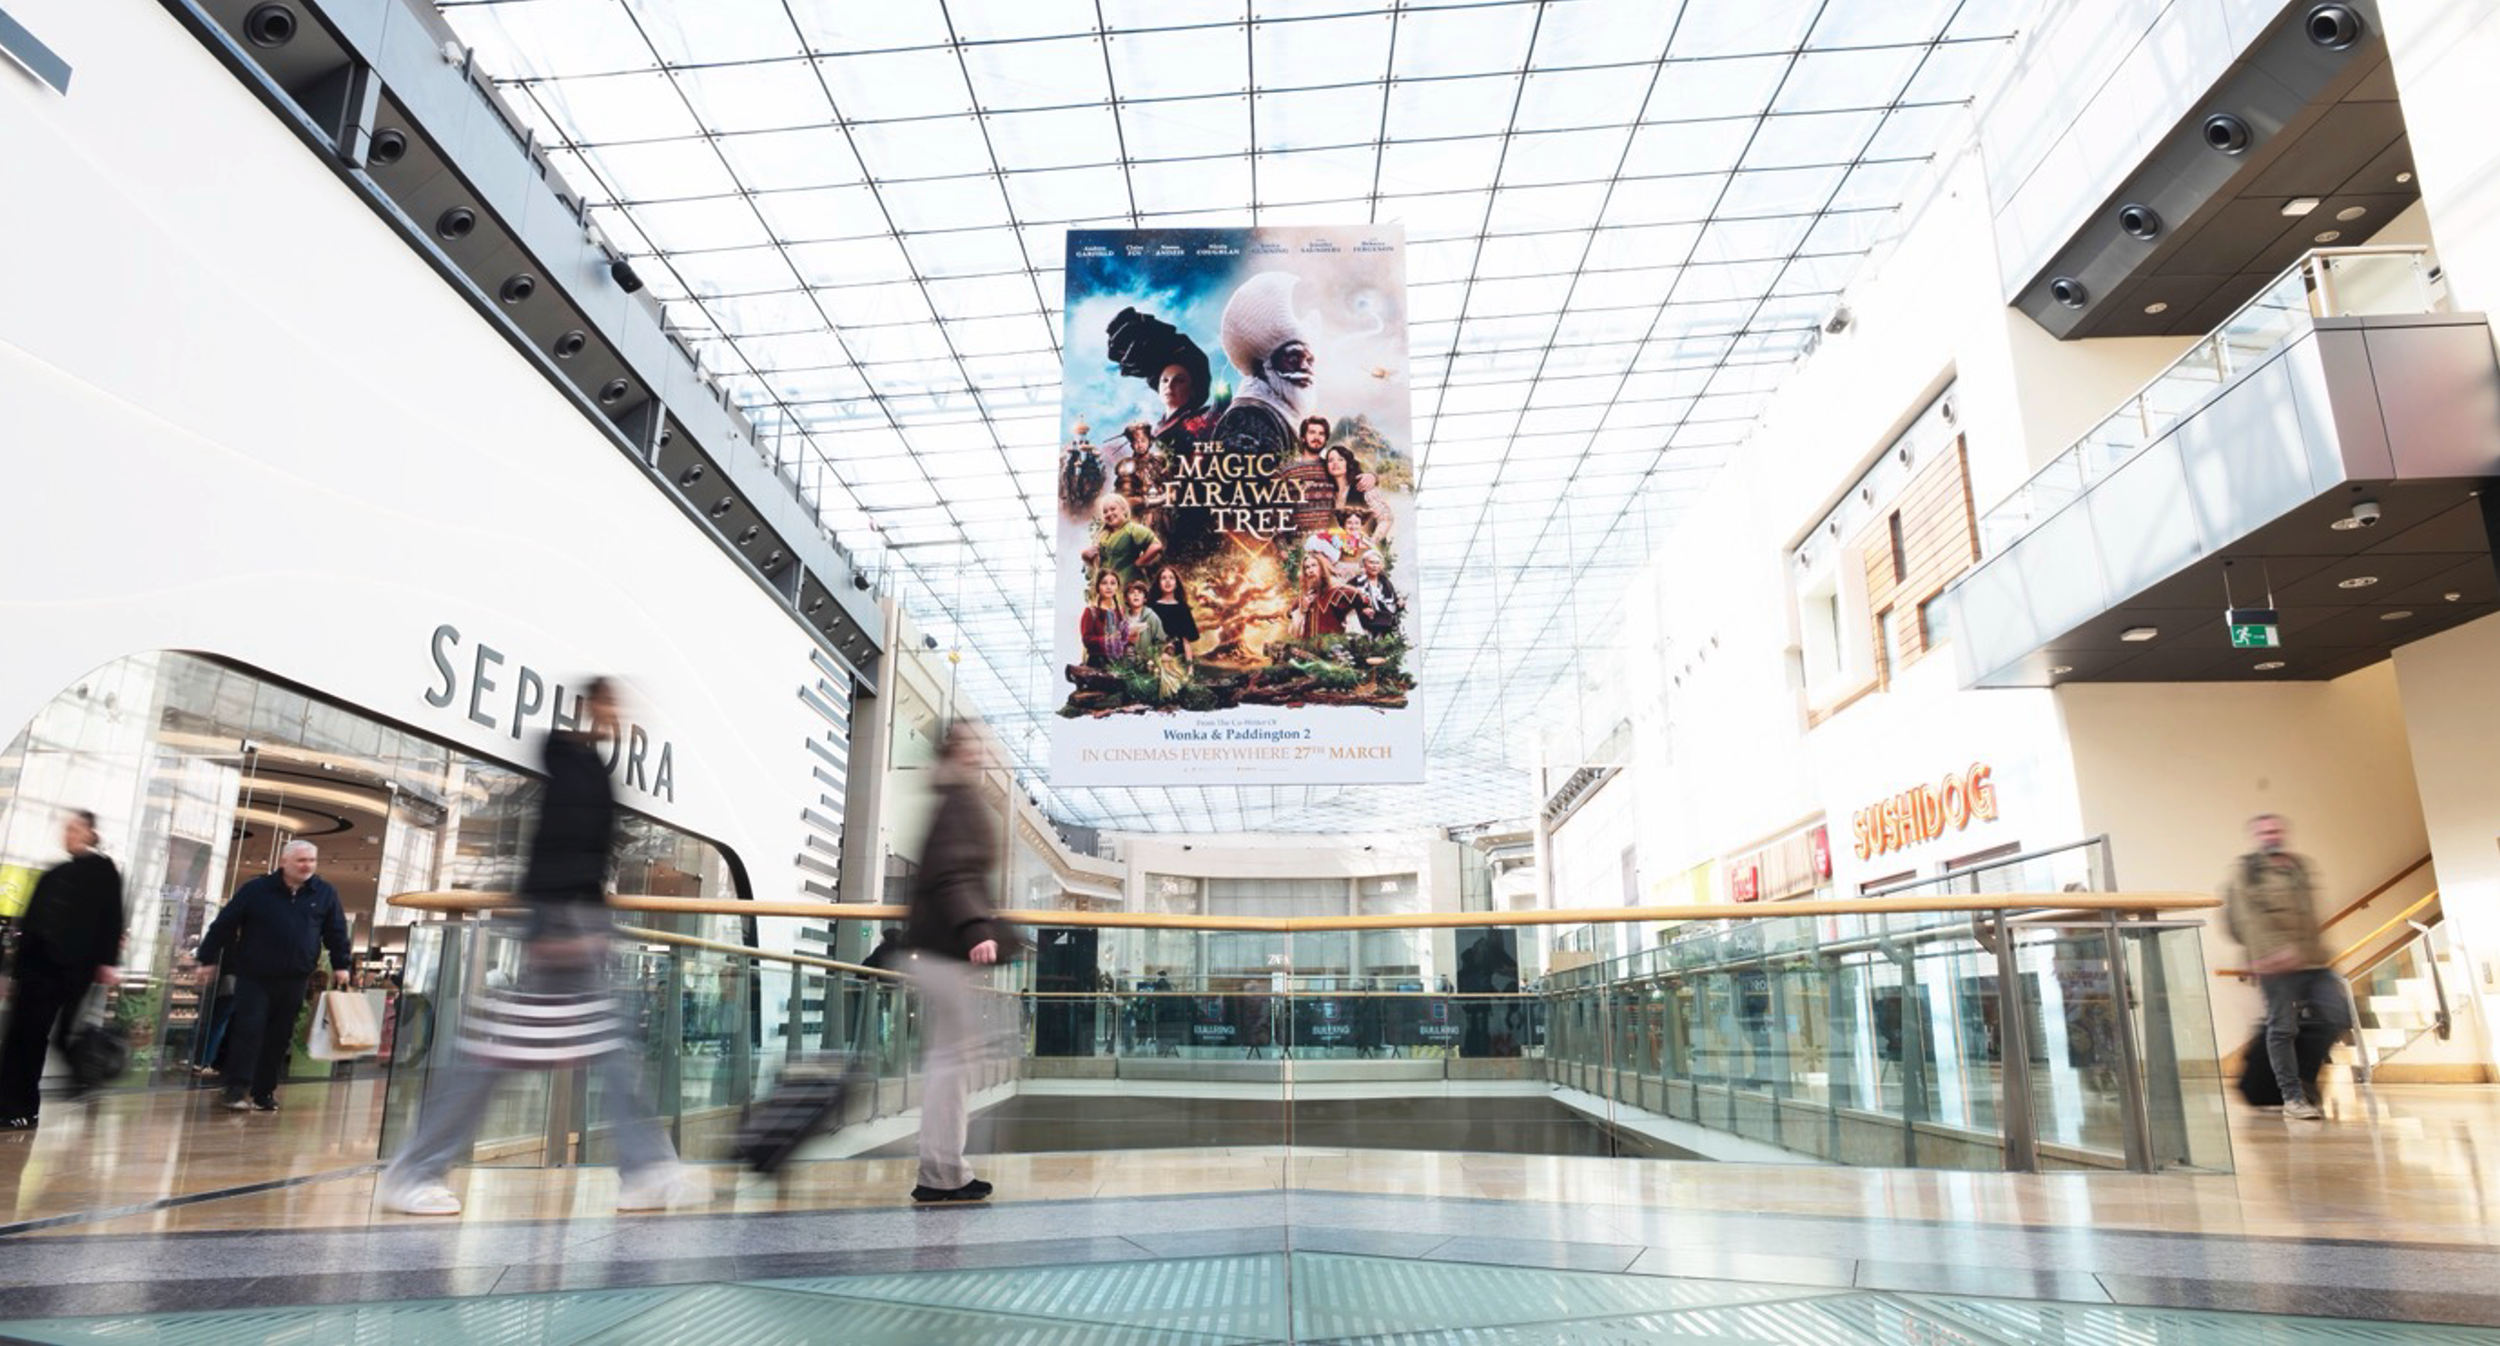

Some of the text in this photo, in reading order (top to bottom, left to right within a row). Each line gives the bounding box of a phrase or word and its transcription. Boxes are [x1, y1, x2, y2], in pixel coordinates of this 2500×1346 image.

[1193, 441, 1225, 453] THE
[1174, 453, 1277, 484] MAGIC
[1162, 478, 1314, 507] FARAWAY
[1210, 507, 1298, 541] TREE
[1163, 728, 1311, 742] Wonka & Paddington 2
[1082, 749, 1099, 762] IN
[1104, 748, 1178, 761] CINEMAS
[1182, 747, 1290, 761] EVERYWHERE
[1329, 745, 1392, 759] MARCH
[1853, 762, 1999, 862] SUSHIDOG
